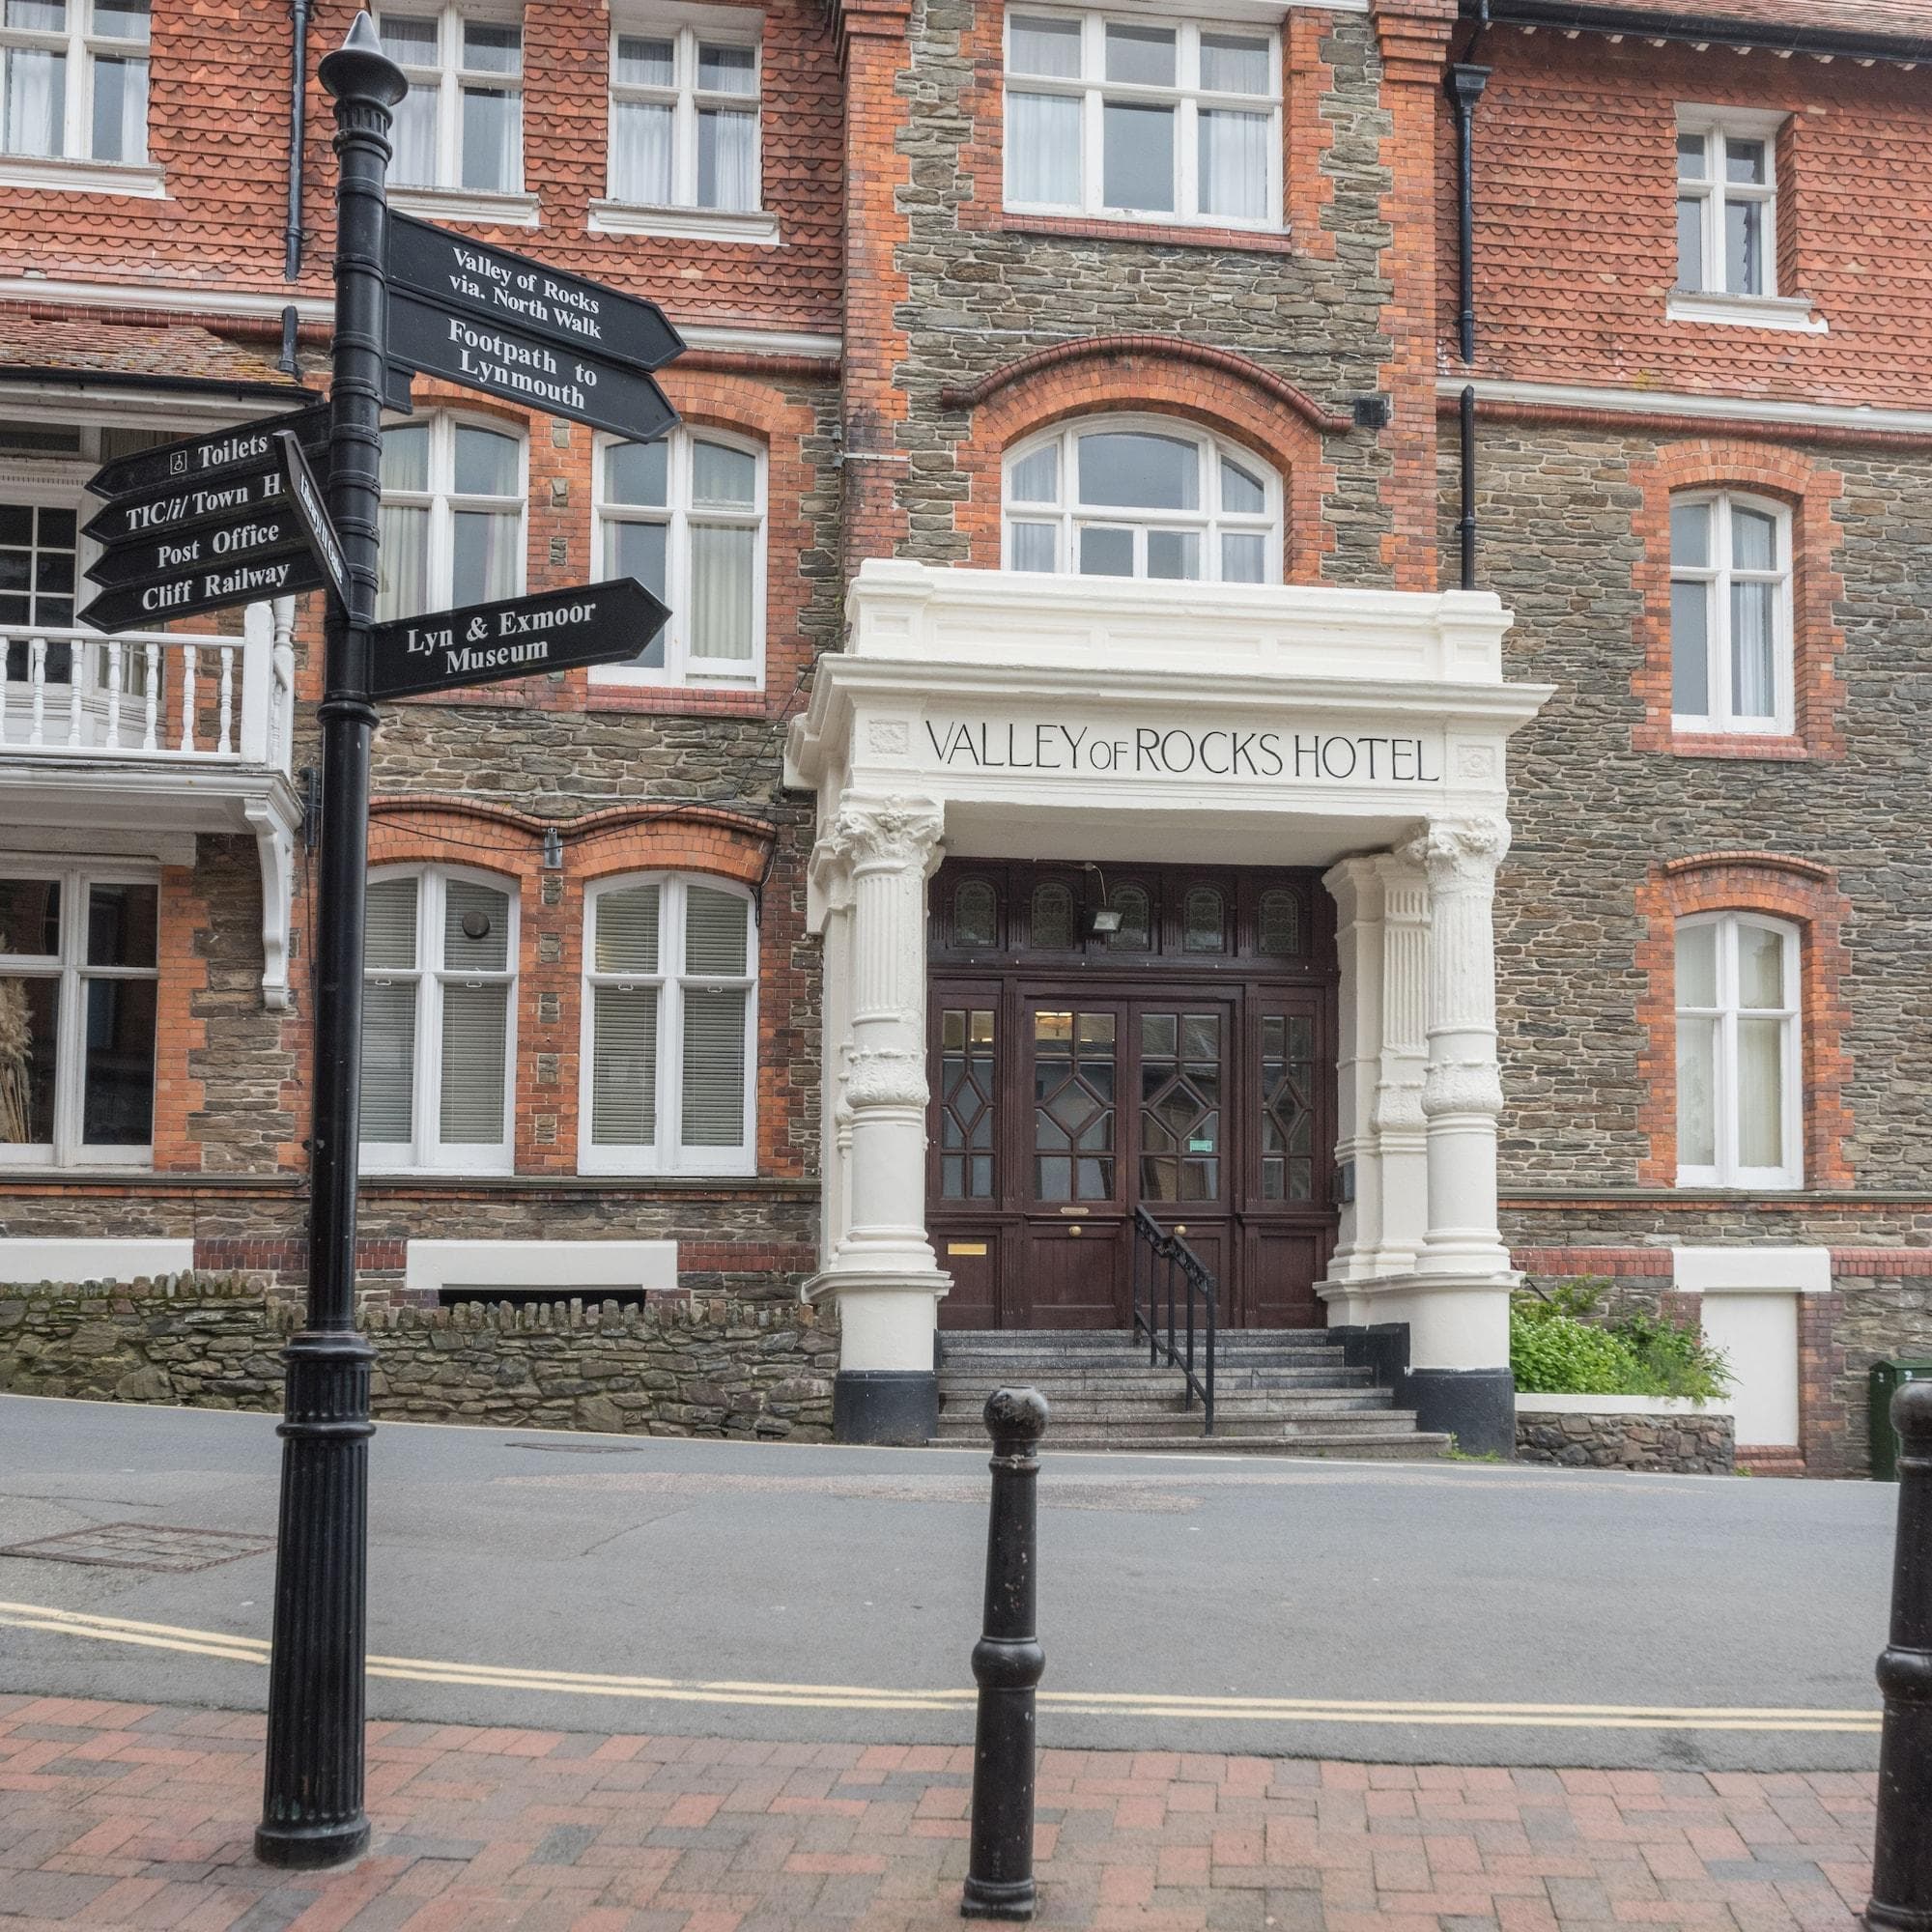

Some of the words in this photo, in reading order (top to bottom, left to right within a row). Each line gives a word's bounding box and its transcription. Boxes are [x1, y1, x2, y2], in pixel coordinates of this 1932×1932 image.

[449, 274, 486, 298] via.
[493, 287, 548, 322] North
[554, 307, 602, 339] Walk
[453, 246, 512, 287] Valley
[517, 274, 536, 292] of
[543, 279, 600, 314] Rocks
[448, 318, 557, 375] Footpath
[575, 363, 597, 386] to
[459, 349, 585, 410] Lynmouth
[198, 435, 268, 469] Toilets
[192, 487, 248, 515] Town
[157, 540, 200, 568] Post
[212, 525, 279, 554] Office
[142, 580, 192, 610] Cliff
[204, 563, 290, 597] Railway
[407, 629, 453, 656] Lyn
[466, 617, 488, 641] &
[498, 603, 596, 637] Exmoor
[445, 640, 549, 674] Museum
[924, 720, 1089, 769] VALLEY
[1089, 740, 1128, 771] OF
[1135, 727, 1284, 776] ROCKS
[1294, 735, 1440, 781] HOTEL
